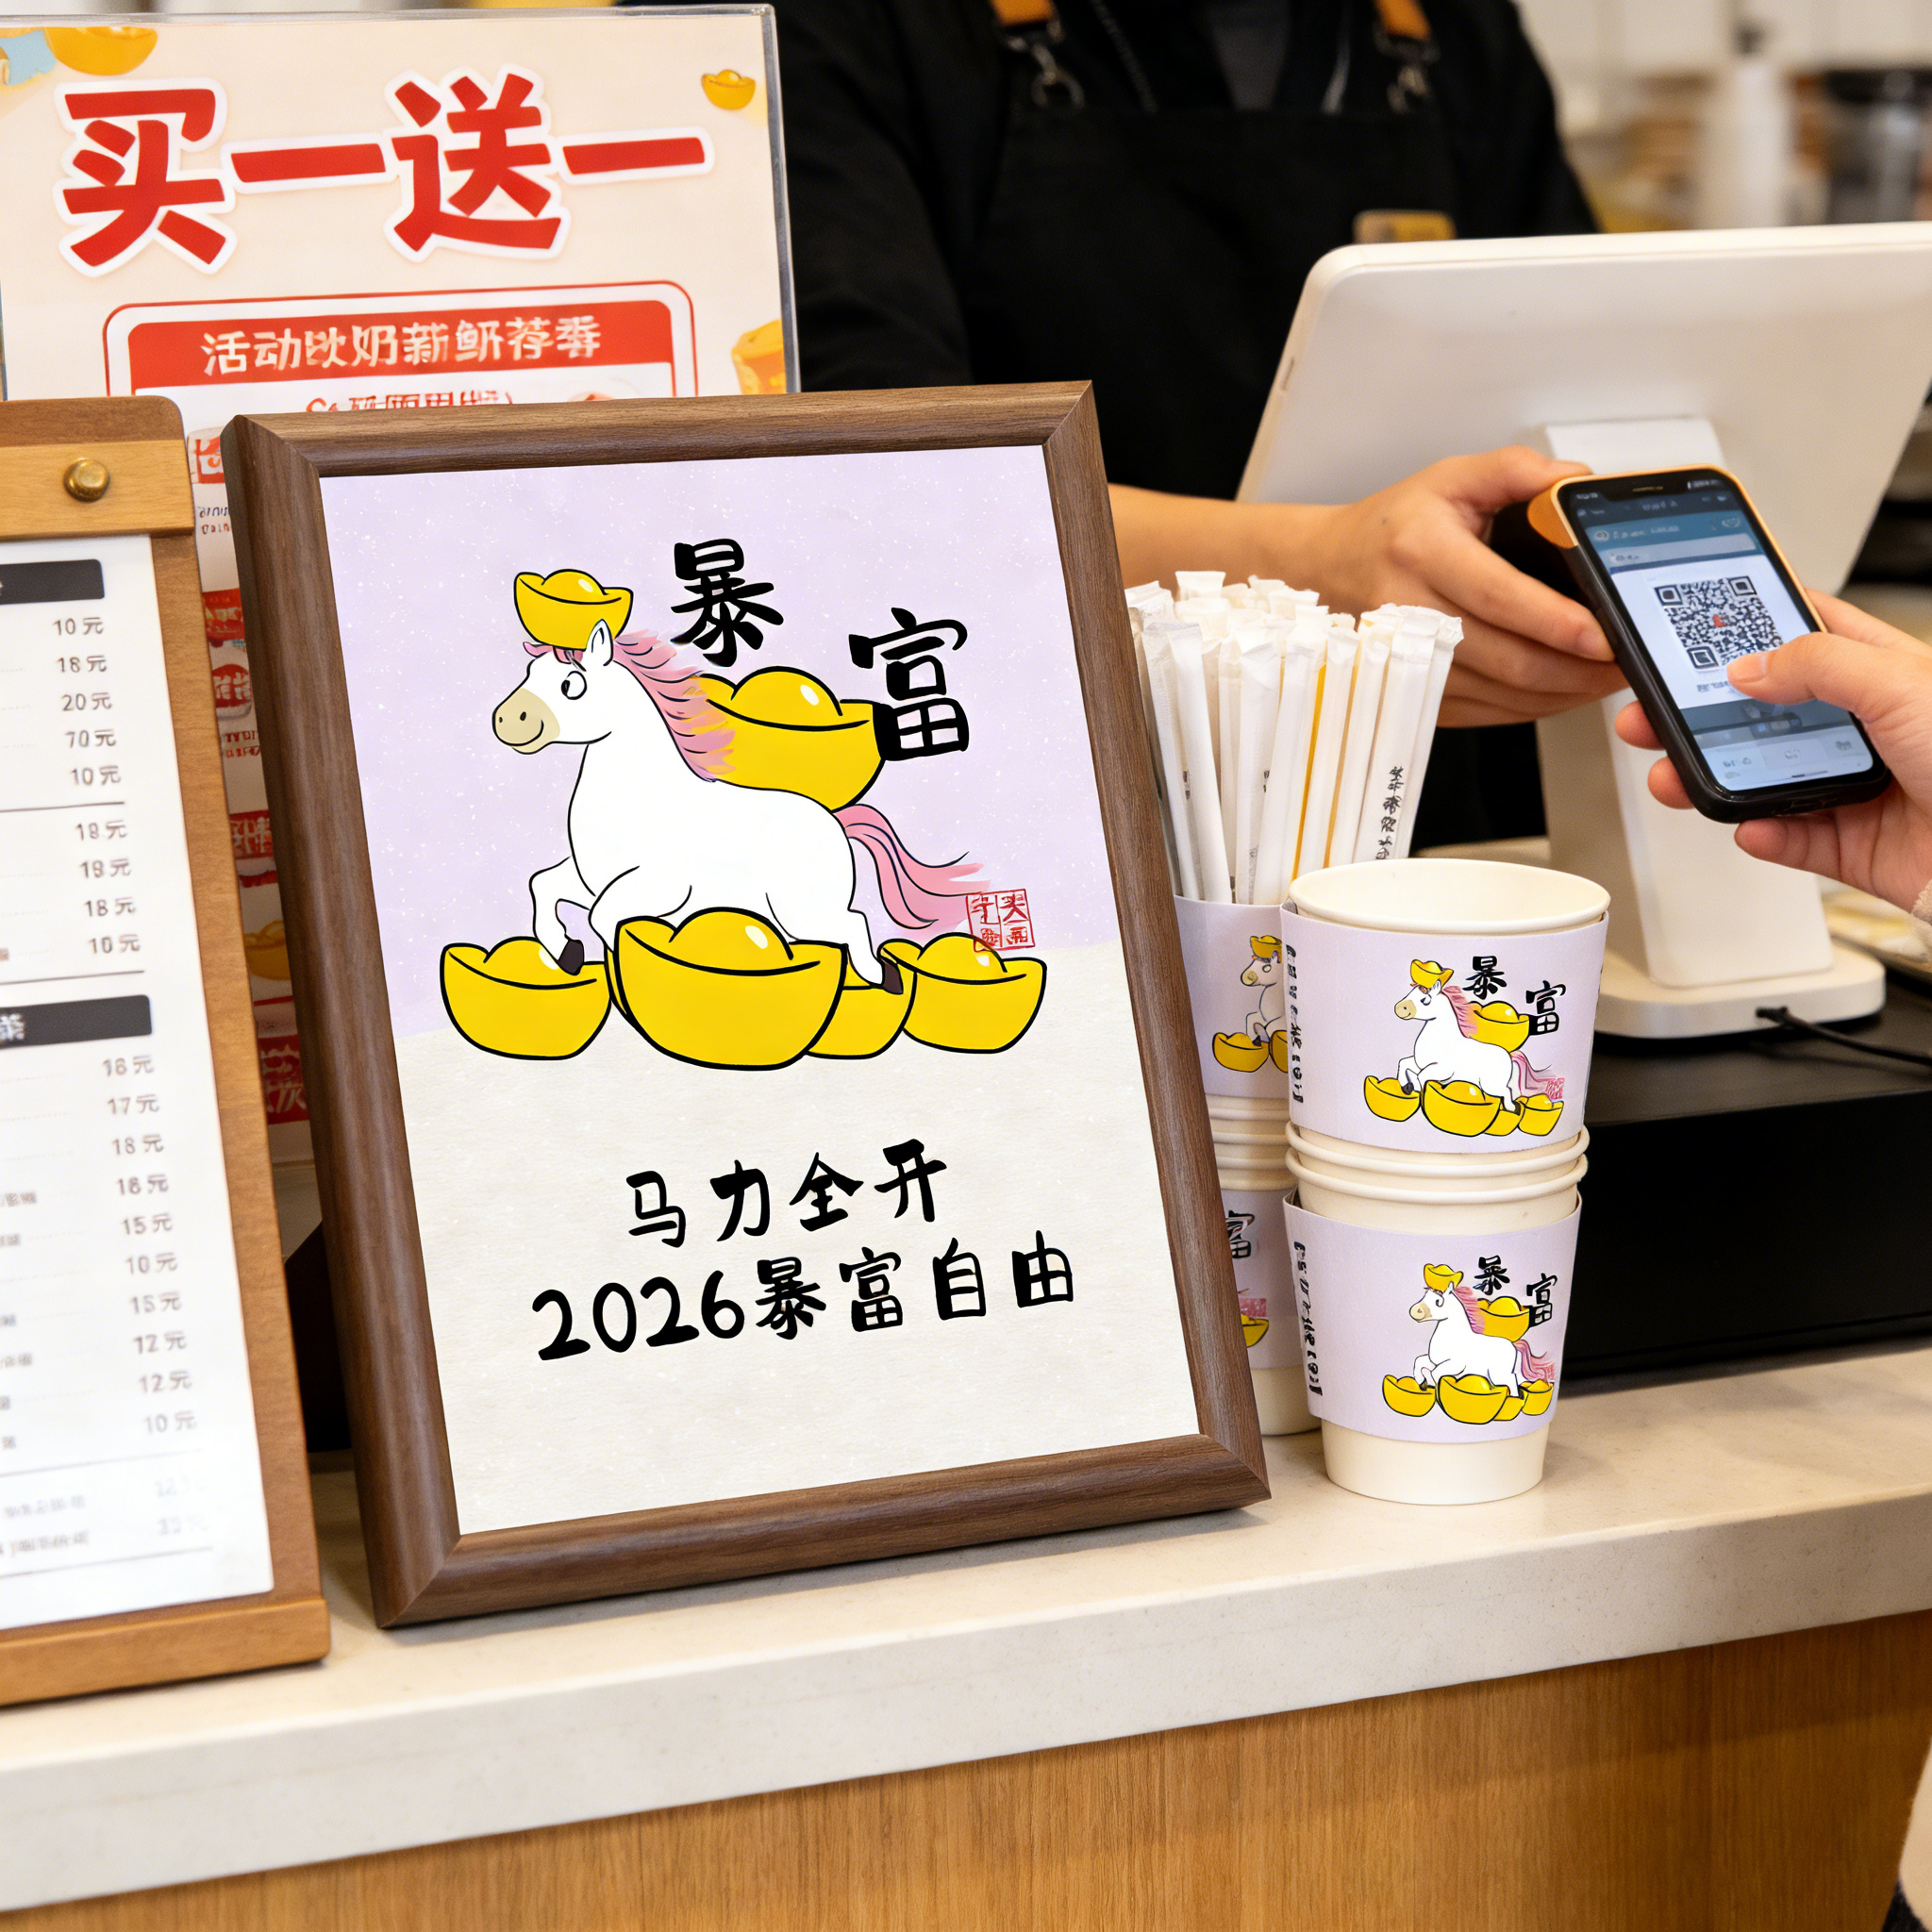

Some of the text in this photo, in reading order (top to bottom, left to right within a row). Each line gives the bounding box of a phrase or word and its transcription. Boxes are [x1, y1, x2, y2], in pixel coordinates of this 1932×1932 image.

[63, 73, 706, 268] 买一送一
[671, 538, 971, 761] 暴富
[625, 1138, 948, 1248] 马力全开
[531, 1229, 1074, 1360] 2026暴富自由
